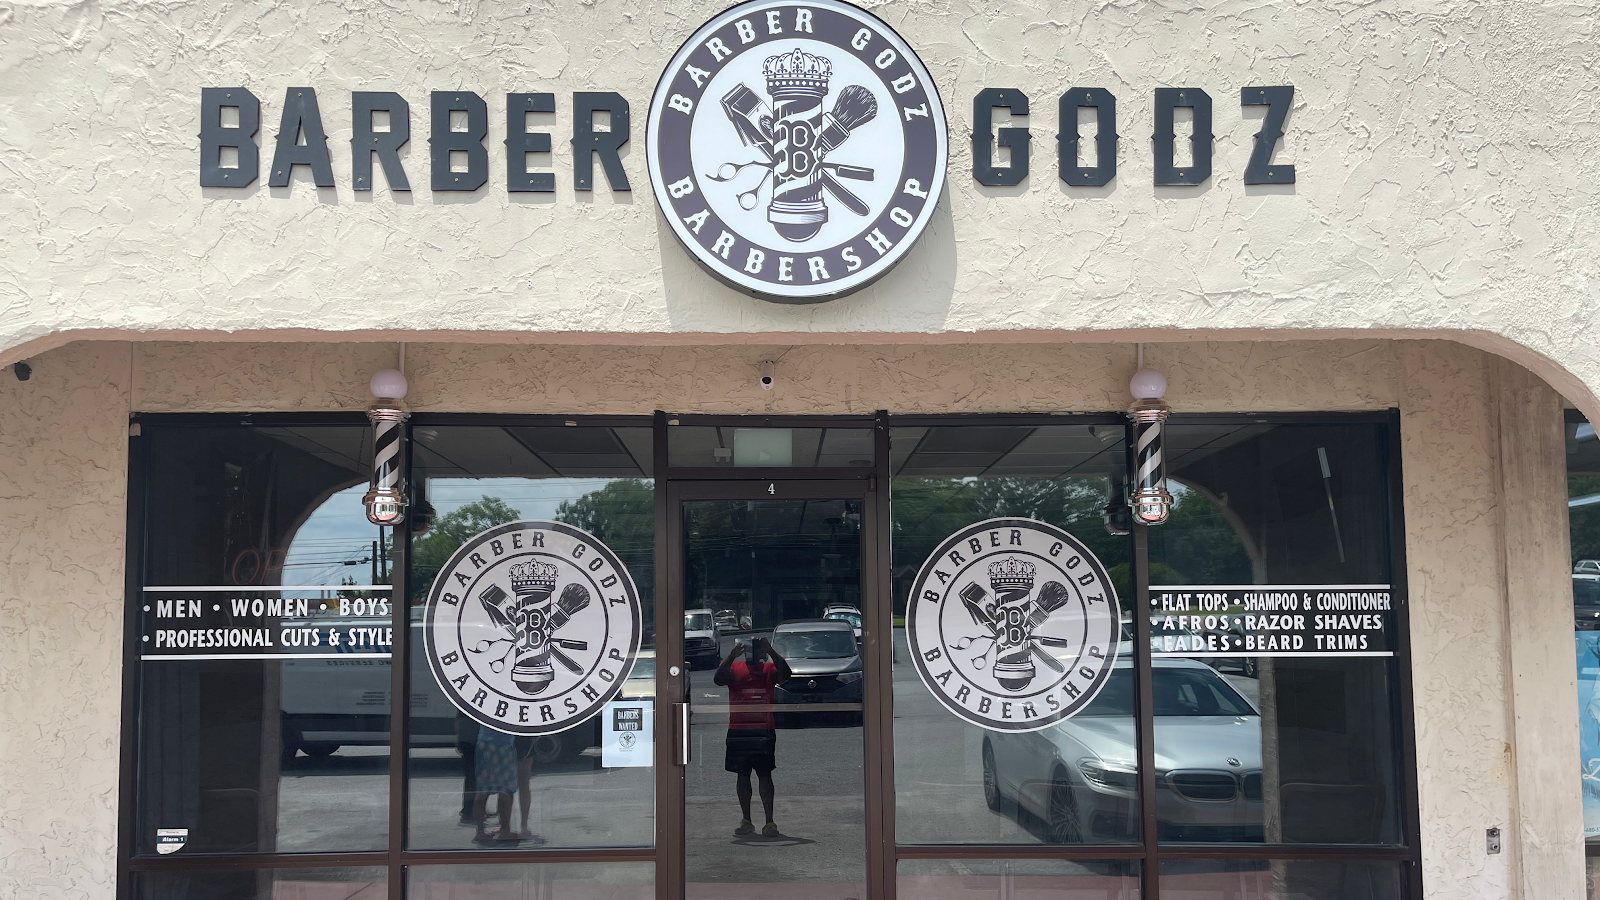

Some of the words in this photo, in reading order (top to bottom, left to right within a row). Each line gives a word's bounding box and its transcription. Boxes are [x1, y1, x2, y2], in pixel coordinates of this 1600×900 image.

[668, 8, 813, 115] BARBER
[850, 27, 929, 121] GODZ
[197, 87, 631, 192] BARBER
[970, 85, 1295, 187] GODZ
[668, 175, 928, 282] BARBERSHOP
[767, 482, 776, 495] 4
[442, 531, 545, 607] BARBER
[572, 543, 626, 607] GODZ
[922, 529, 1022, 604] BARBER
[1048, 541, 1104, 605] GODZ
[156, 600, 202, 618] MEN
[231, 598, 308, 617] WOMEN
[339, 598, 389, 616] BOYS
[1162, 593, 1191, 611] FLAT
[1196, 593, 1228, 611] TOPS
[1243, 593, 1298, 611] SHAMPOO
[1303, 593, 1312, 610] &
[1316, 592, 1391, 611] CONDITIONER
[1162, 615, 1229, 630] AFROS
[1245, 614, 1306, 630] RAZOR
[1314, 614, 1382, 630] SHAVES
[155, 628, 273, 648] PROFESSIONAL
[280, 628, 320, 647] CUTS
[328, 628, 341, 647] &
[1164, 634, 1230, 651] FADES
[1245, 634, 1304, 650] BEARD
[1314, 634, 1368, 650] TRIMS
[441, 648, 626, 723] BARBERSHOP
[923, 645, 1105, 719] BARBERSHOP
[618, 722, 639, 731] WANTED
